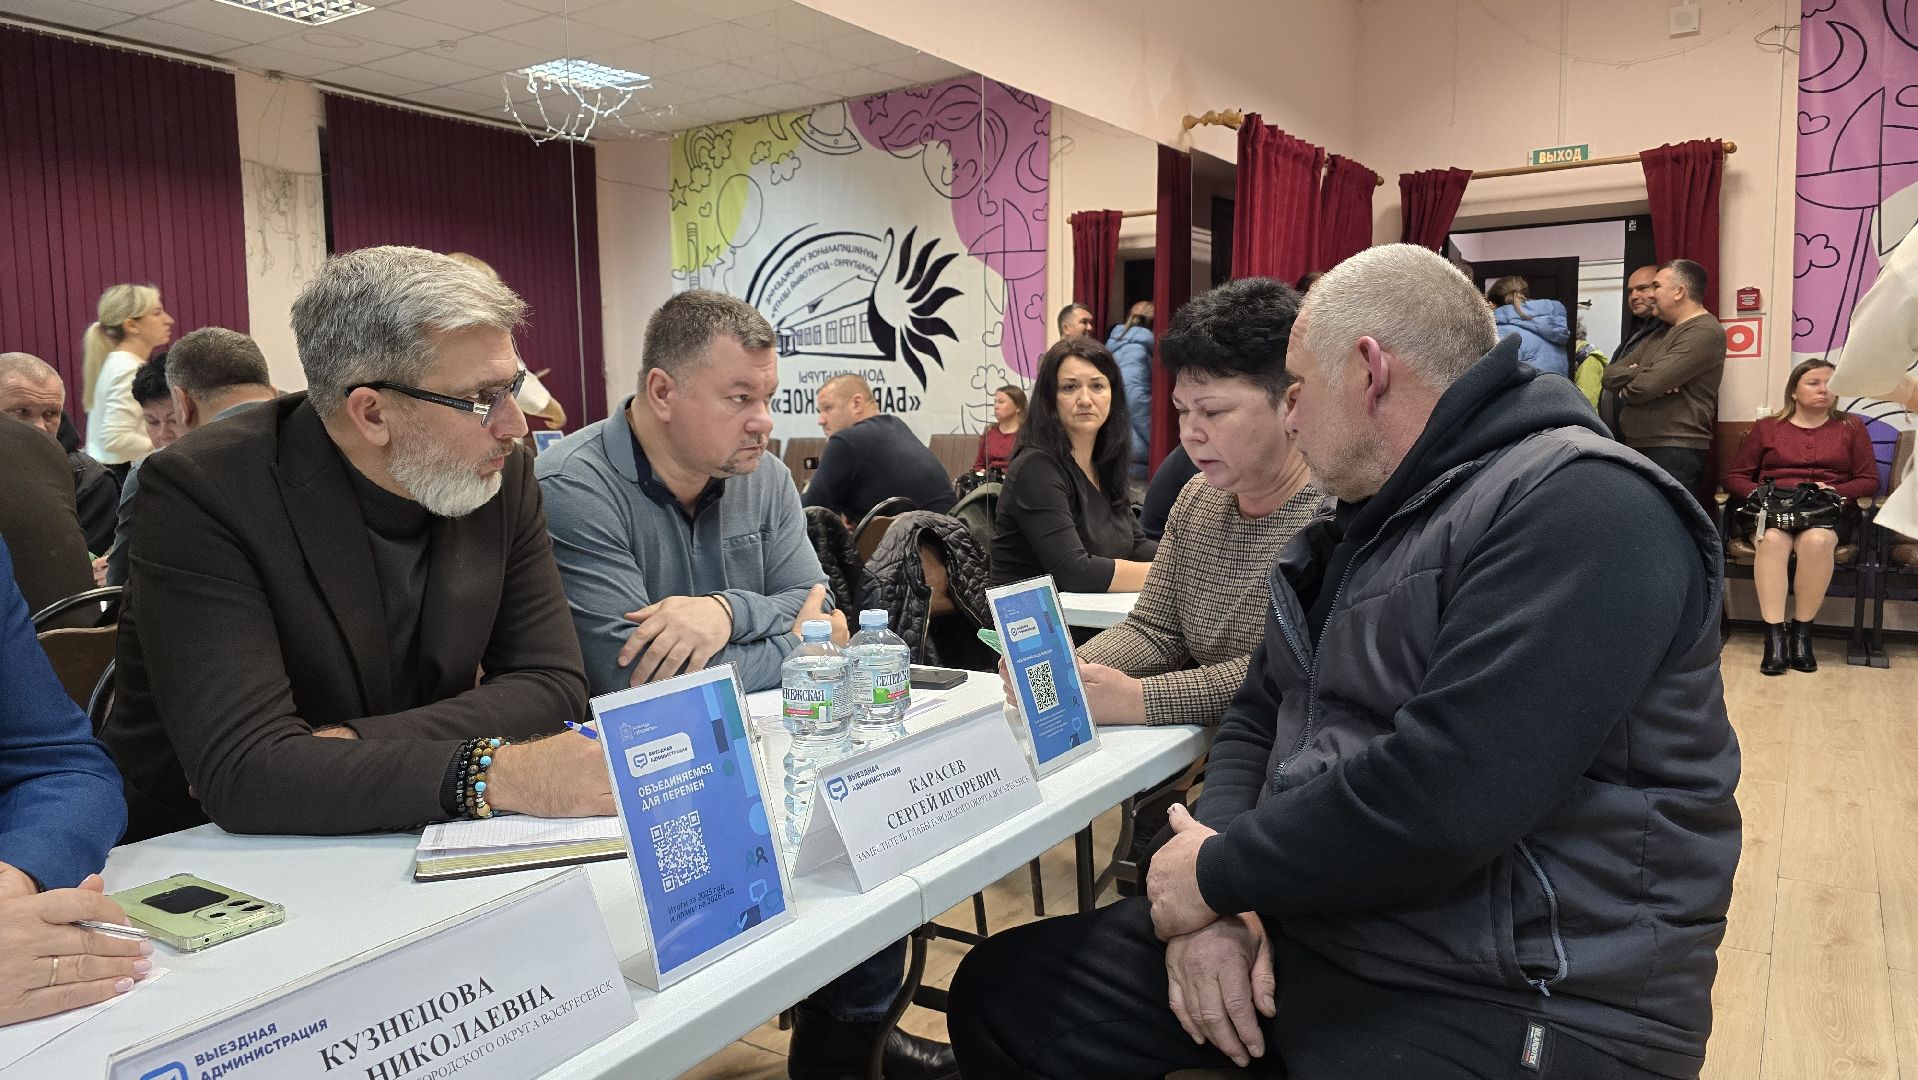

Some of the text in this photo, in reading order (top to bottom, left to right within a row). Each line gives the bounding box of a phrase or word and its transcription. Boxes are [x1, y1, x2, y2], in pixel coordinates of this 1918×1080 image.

[1539, 148, 1581, 164] ВЫХОД
[638, 762, 714, 798] ОБЪЕДИНЯЕМСЯ
[847, 764, 880, 783] ВЫЕЗДНАЯ
[852, 766, 902, 792] АДМИНИСТРАЦИЯ
[908, 759, 966, 794] КАРАСЕВ
[641, 778, 705, 813] ДЛЯ ПЕРЕМЕН
[887, 767, 1002, 830] СЕРГЕЙ ИГОРЕВИЧ
[856, 832, 908, 862] ЗАМЕСТИТЕЛЬ
[667, 900, 689, 915] Итоги
[697, 887, 713, 901] 2025
[713, 883, 726, 893] год
[676, 904, 698, 920] планы
[706, 892, 723, 905] 2026
[722, 887, 735, 898] год
[318, 976, 495, 1072] КУЗНЕЦОВА
[495, 1019, 541, 1048] ОКРУГА
[541, 979, 615, 1025] ВОСКРЕСЕНСК
[195, 1022, 278, 1067] ВЫЕЗДНАЯ
[201, 1018, 328, 1080] АДМИНИСТРАЦИЯ
[364, 984, 555, 1080] НИКОЛАЕВНА
